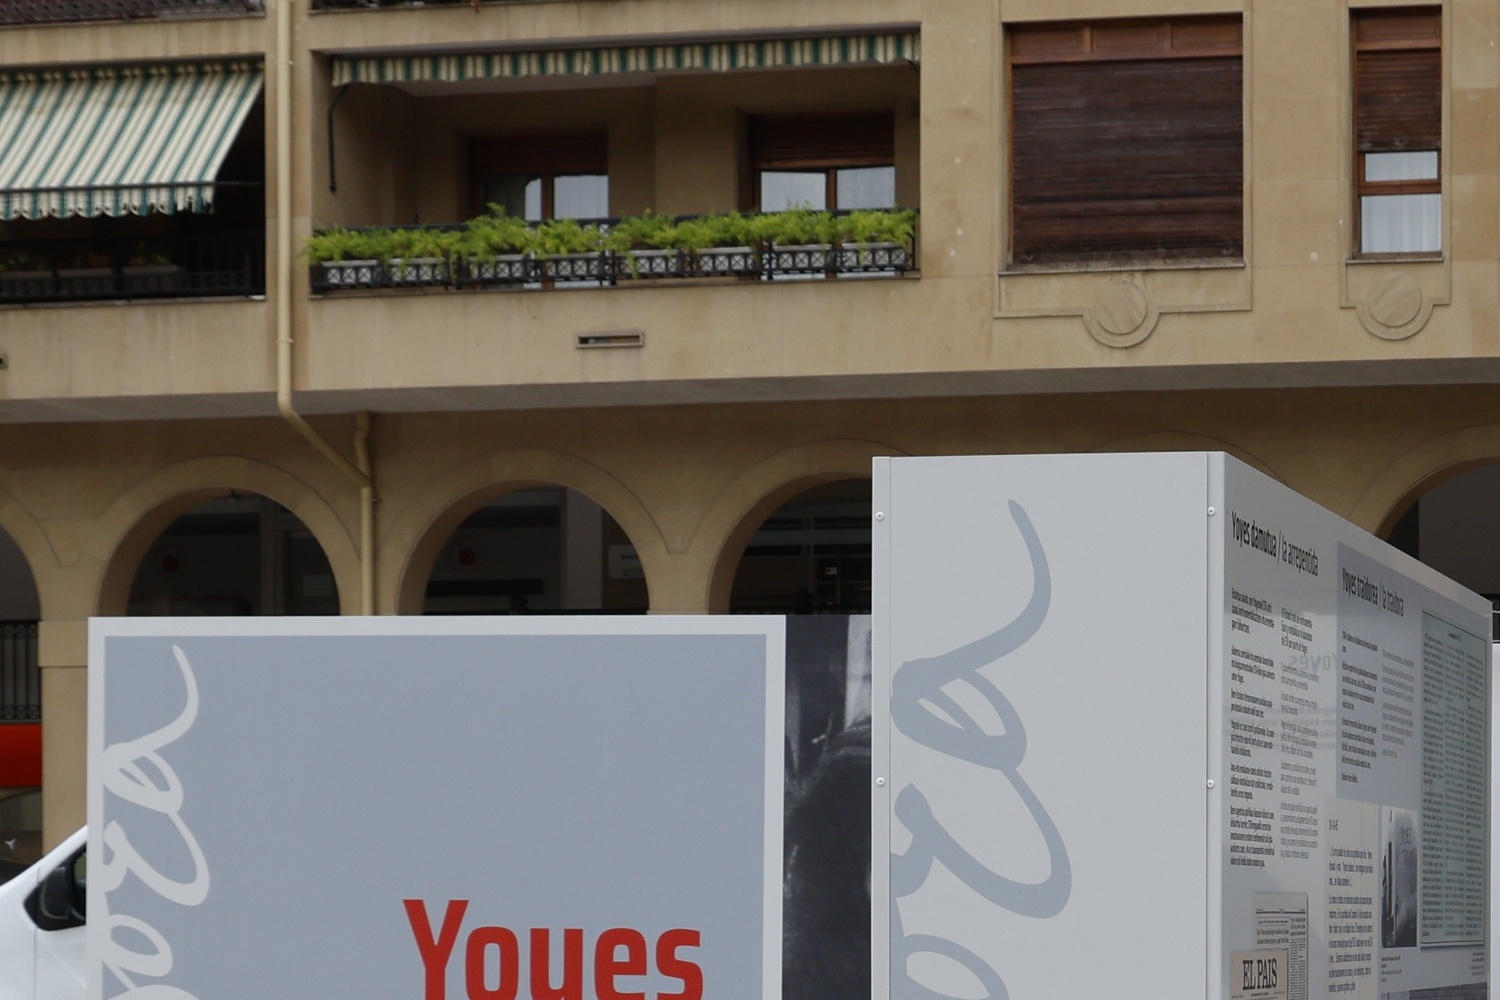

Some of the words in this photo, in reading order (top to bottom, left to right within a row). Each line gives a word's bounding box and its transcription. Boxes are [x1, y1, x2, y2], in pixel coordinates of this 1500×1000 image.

[1231, 511, 1250, 547] Yoyes
[1251, 520, 1277, 557] damutua
[1282, 534, 1287, 562] la
[1288, 544, 1318, 577] arrepentida
[1342, 567, 1356, 597] Yoyes
[1243, 960, 1256, 990] EL
[1257, 958, 1277, 989] PAIS
